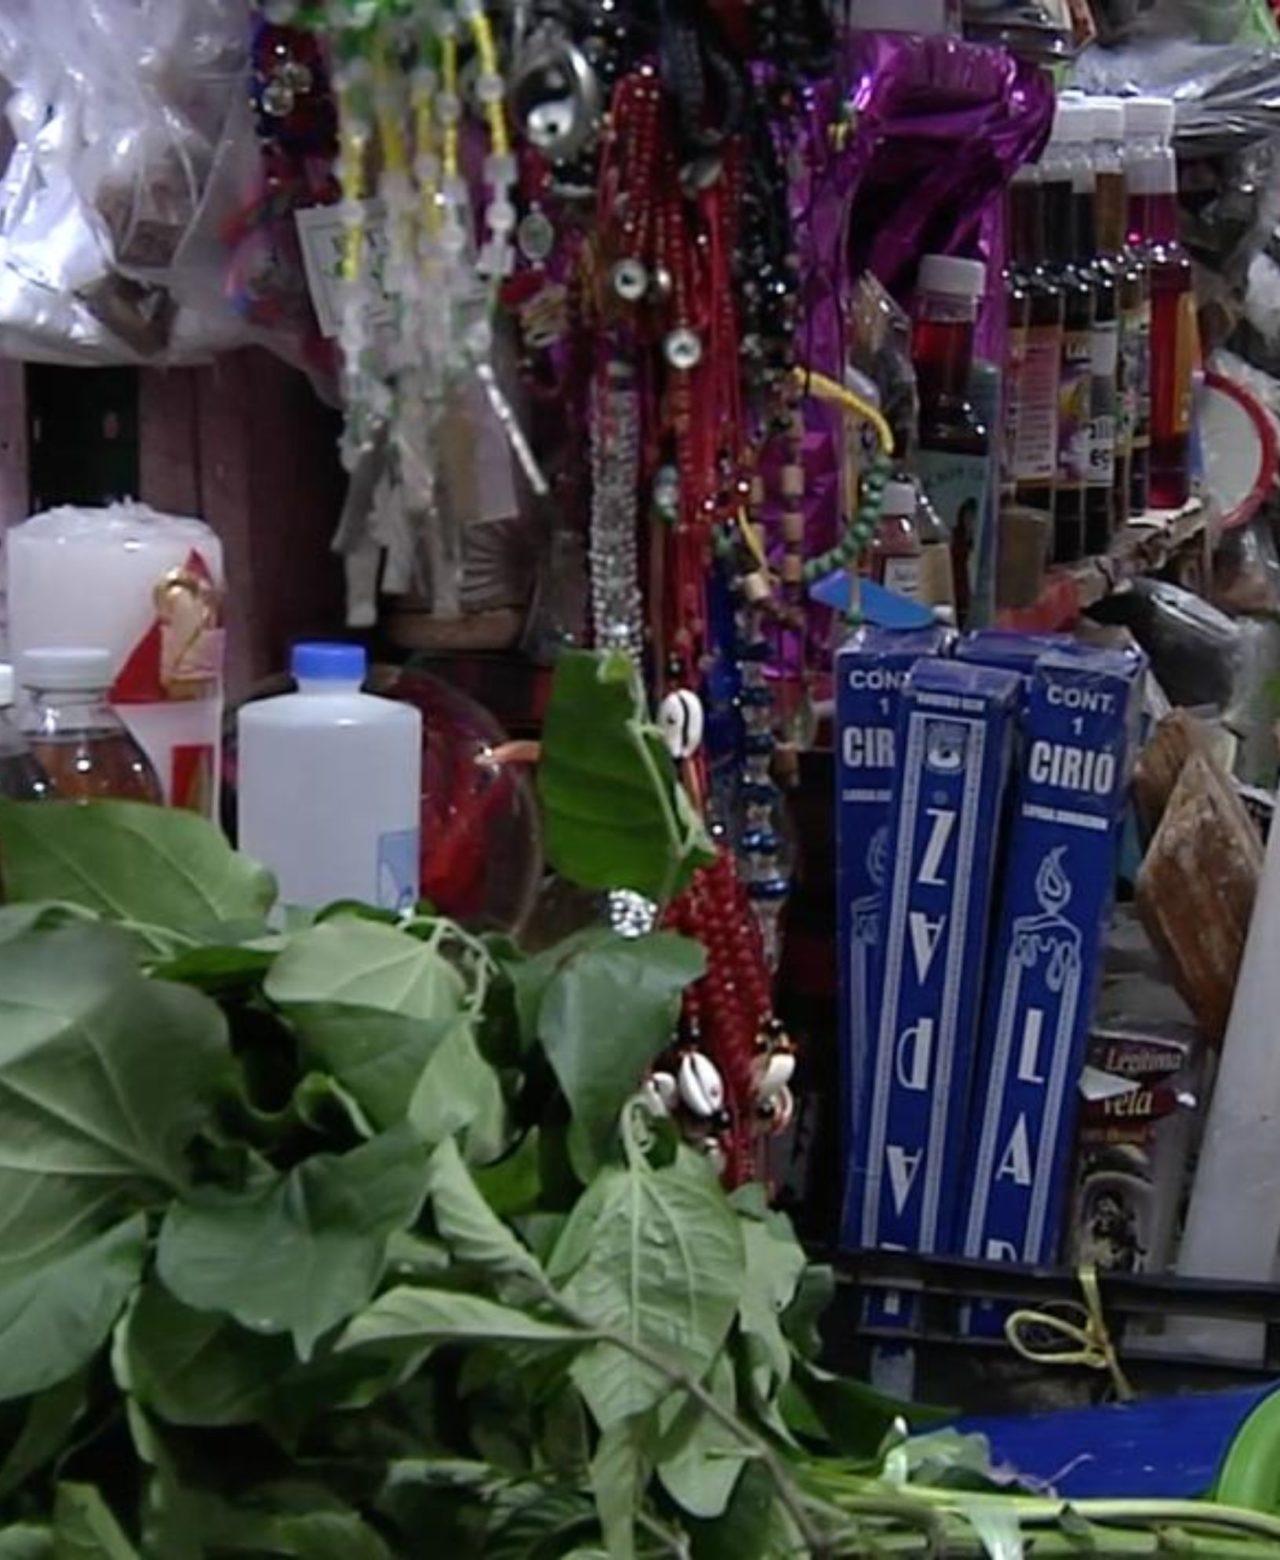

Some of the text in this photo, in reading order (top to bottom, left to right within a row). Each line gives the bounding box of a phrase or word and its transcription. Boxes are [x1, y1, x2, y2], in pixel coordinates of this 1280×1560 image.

[849, 669, 904, 691] CON
[879, 697, 889, 716] 1
[1047, 684, 1116, 715] CONT.
[1071, 716, 1084, 736] 1
[842, 726, 896, 768] CIR
